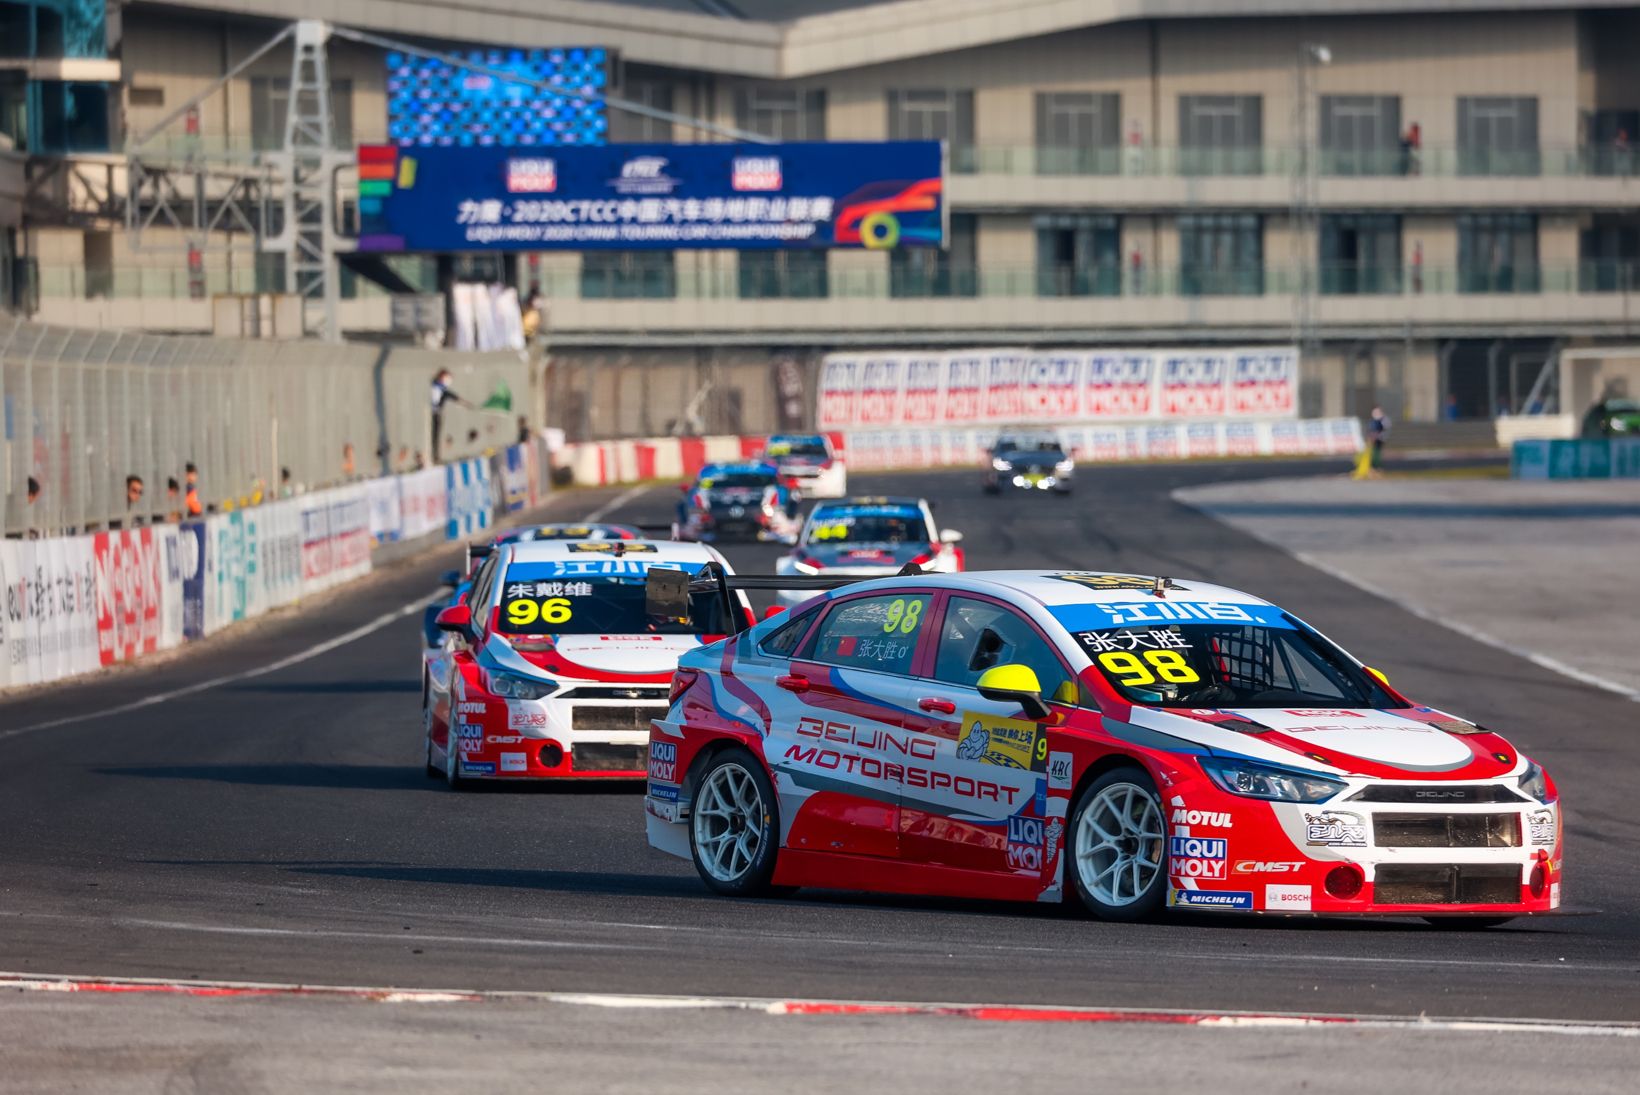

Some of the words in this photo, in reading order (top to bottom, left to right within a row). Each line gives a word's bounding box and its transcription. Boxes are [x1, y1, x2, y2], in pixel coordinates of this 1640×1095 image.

[507, 582, 593, 598] 朱戴维
[507, 598, 572, 625] 96
[884, 599, 922, 633] 98
[858, 639, 898, 659] 张大胜
[1079, 629, 1193, 652] 张大胜
[1098, 650, 1200, 686] 98
[797, 717, 936, 760] BEIJING
[651, 742, 675, 762] LIQUI
[650, 760, 675, 780] MOLY
[784, 744, 1020, 805] MOTORSPORT
[1172, 809, 1233, 828] MOTUL
[1172, 839, 1223, 858] LIQUI
[1172, 860, 1224, 877] MOLY
[1235, 861, 1306, 873] CMST
[1190, 895, 1246, 904] MICHELIN
[1280, 893, 1309, 901] BOSCH
